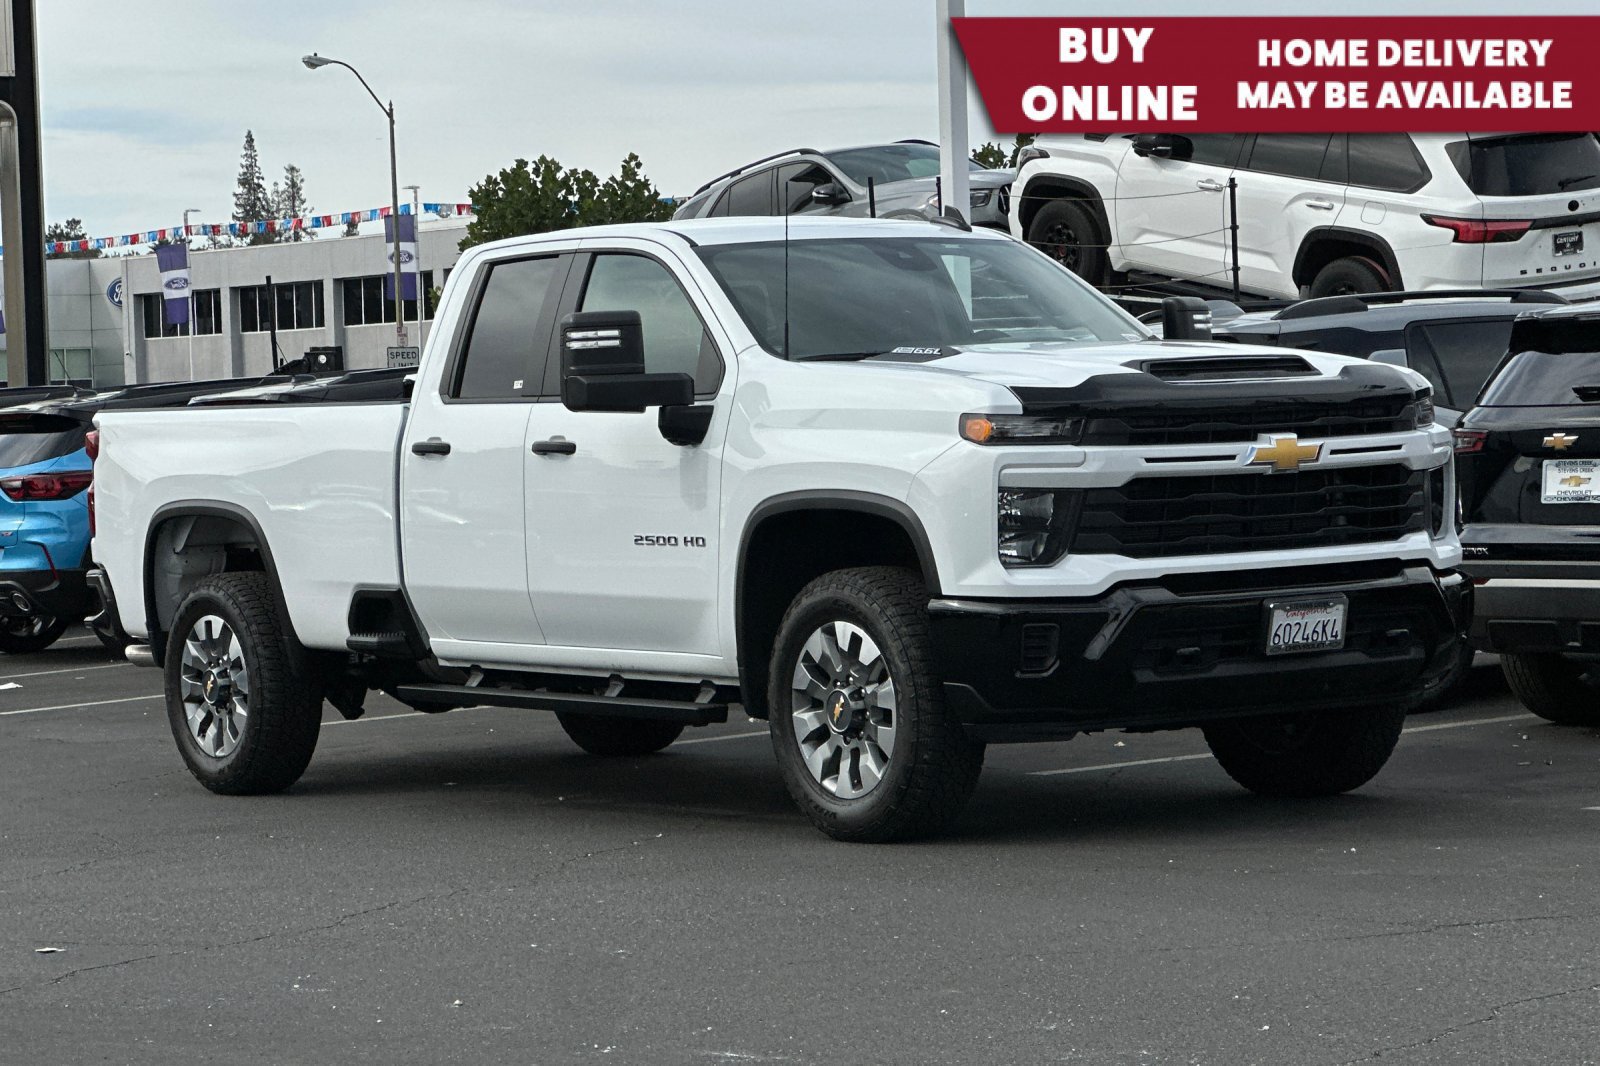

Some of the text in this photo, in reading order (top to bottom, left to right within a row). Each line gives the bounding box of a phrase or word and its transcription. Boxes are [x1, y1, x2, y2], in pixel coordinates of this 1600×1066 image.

[1519, 260, 1597, 275] SEQUOI
[389, 351, 417, 360] SPEED
[633, 534, 706, 548] 2500 HD
[1272, 618, 1339, 645] 60246K4
